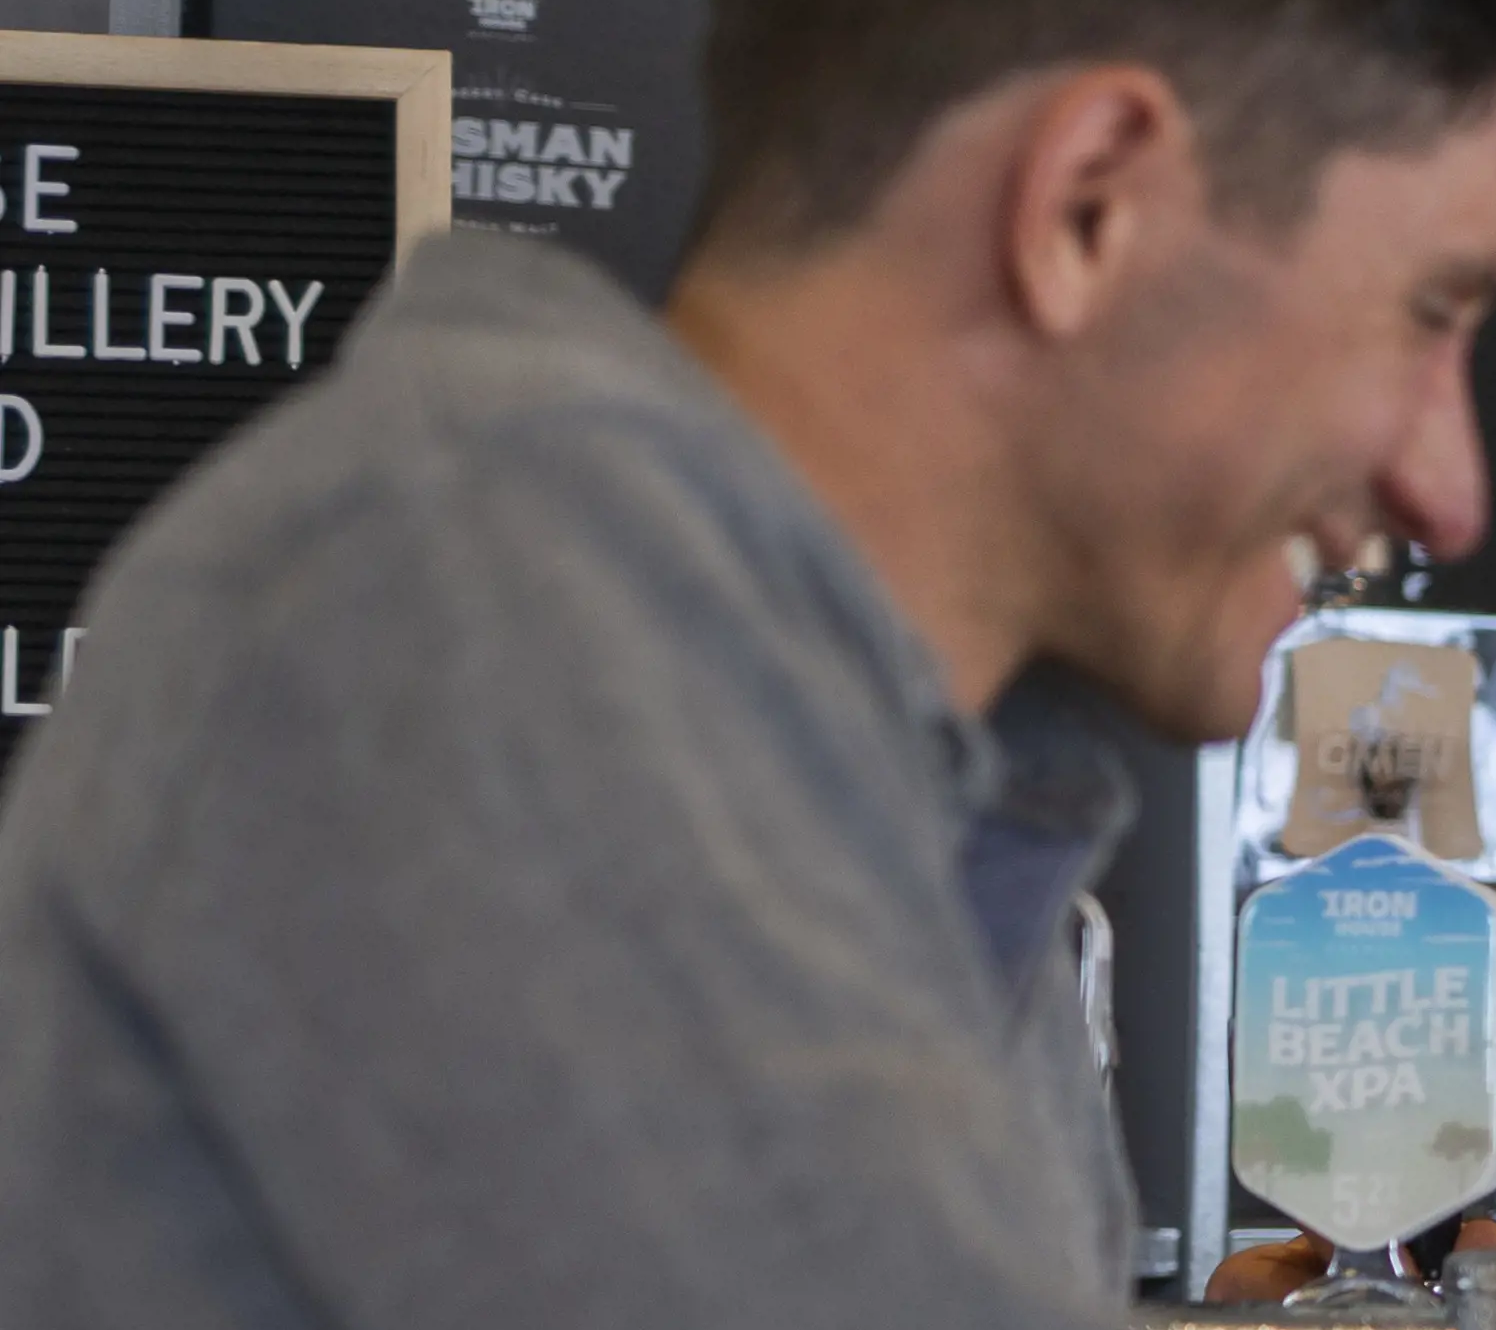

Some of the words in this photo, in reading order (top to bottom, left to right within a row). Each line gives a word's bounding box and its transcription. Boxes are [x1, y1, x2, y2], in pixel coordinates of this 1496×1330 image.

[452, 116, 634, 169] SMAN
[452, 159, 627, 210] HISKY
[1317, 889, 1419, 918] IRON
[1272, 966, 1469, 1020] LITTLE
[1268, 1012, 1470, 1065] BEACH
[1308, 1061, 1426, 1113] XPA
